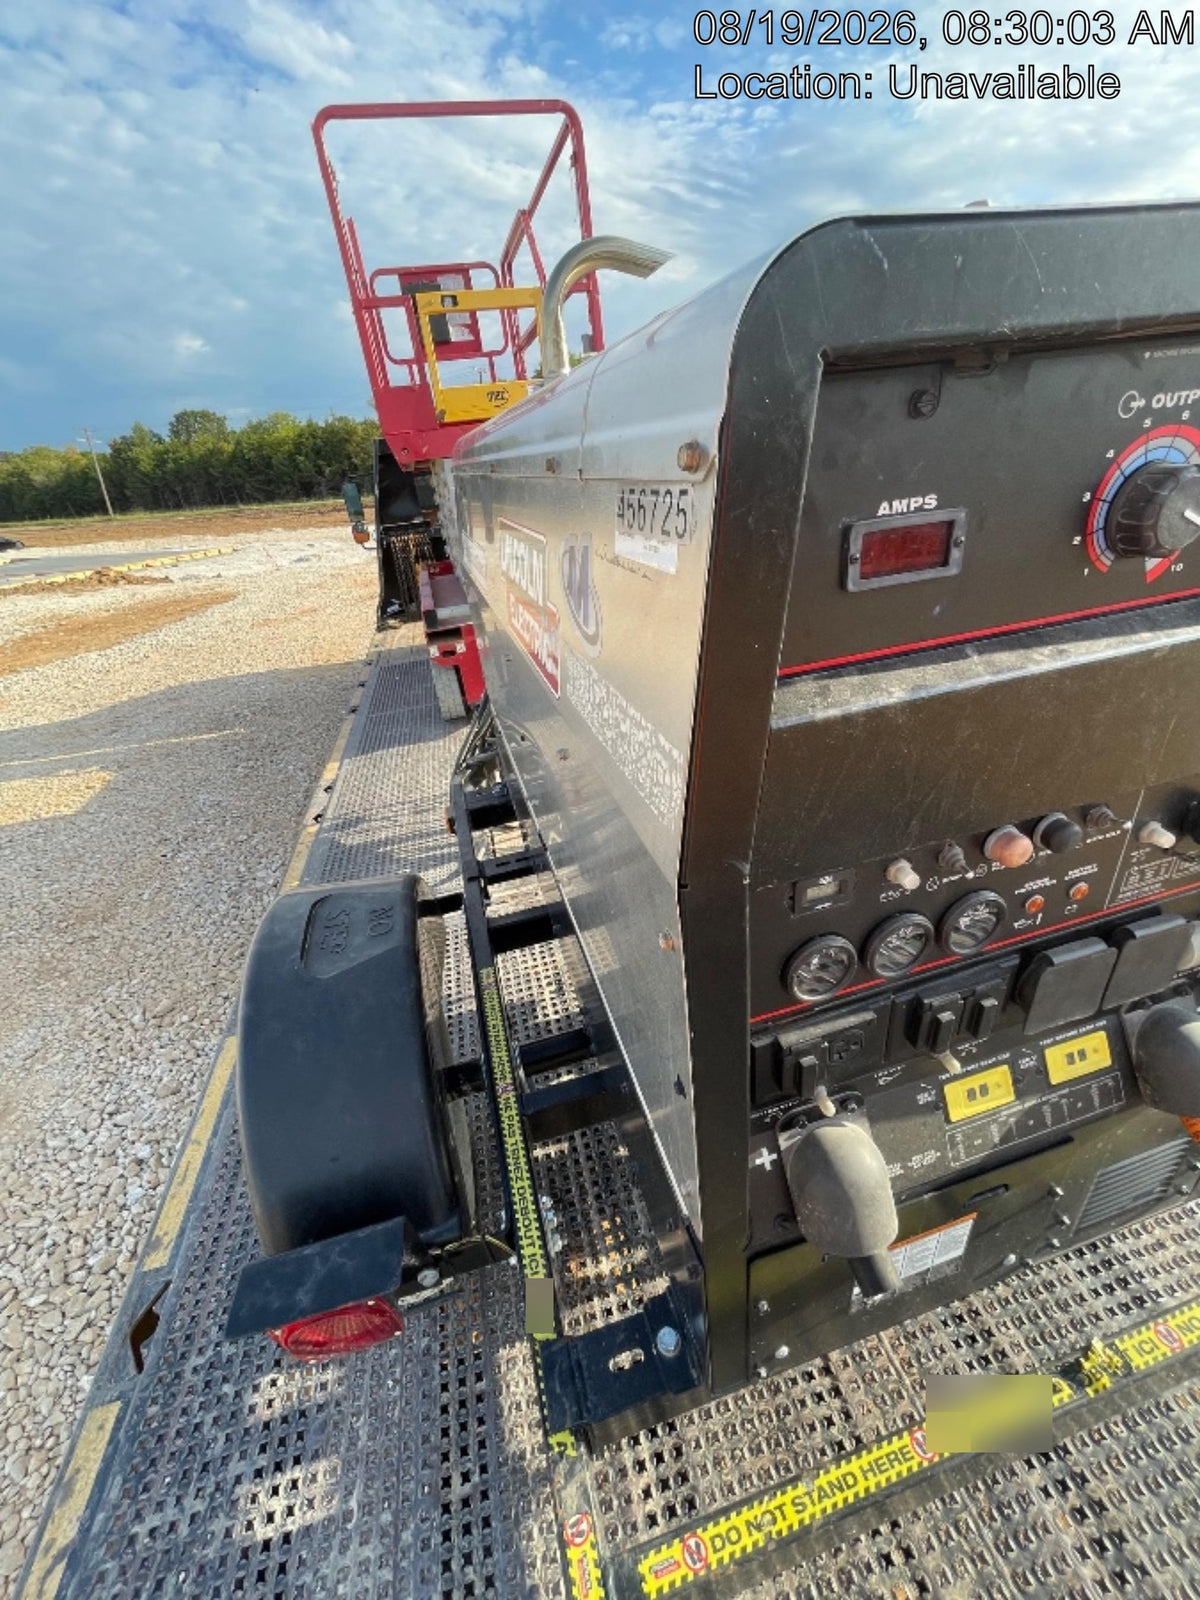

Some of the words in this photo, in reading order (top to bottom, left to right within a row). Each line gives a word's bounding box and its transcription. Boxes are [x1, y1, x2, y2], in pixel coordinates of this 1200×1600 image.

[616, 488, 689, 540] 456725
[876, 493, 938, 516] AMPS
[516, 1187, 536, 1249] DEBOUT
[527, 1253, 540, 1277] ICI
[1132, 1337, 1160, 1358] ICI
[709, 1525, 743, 1554] DO
[747, 1505, 787, 1537] NOT
[793, 1472, 860, 1516] STAND
[858, 1443, 915, 1482] HERE
